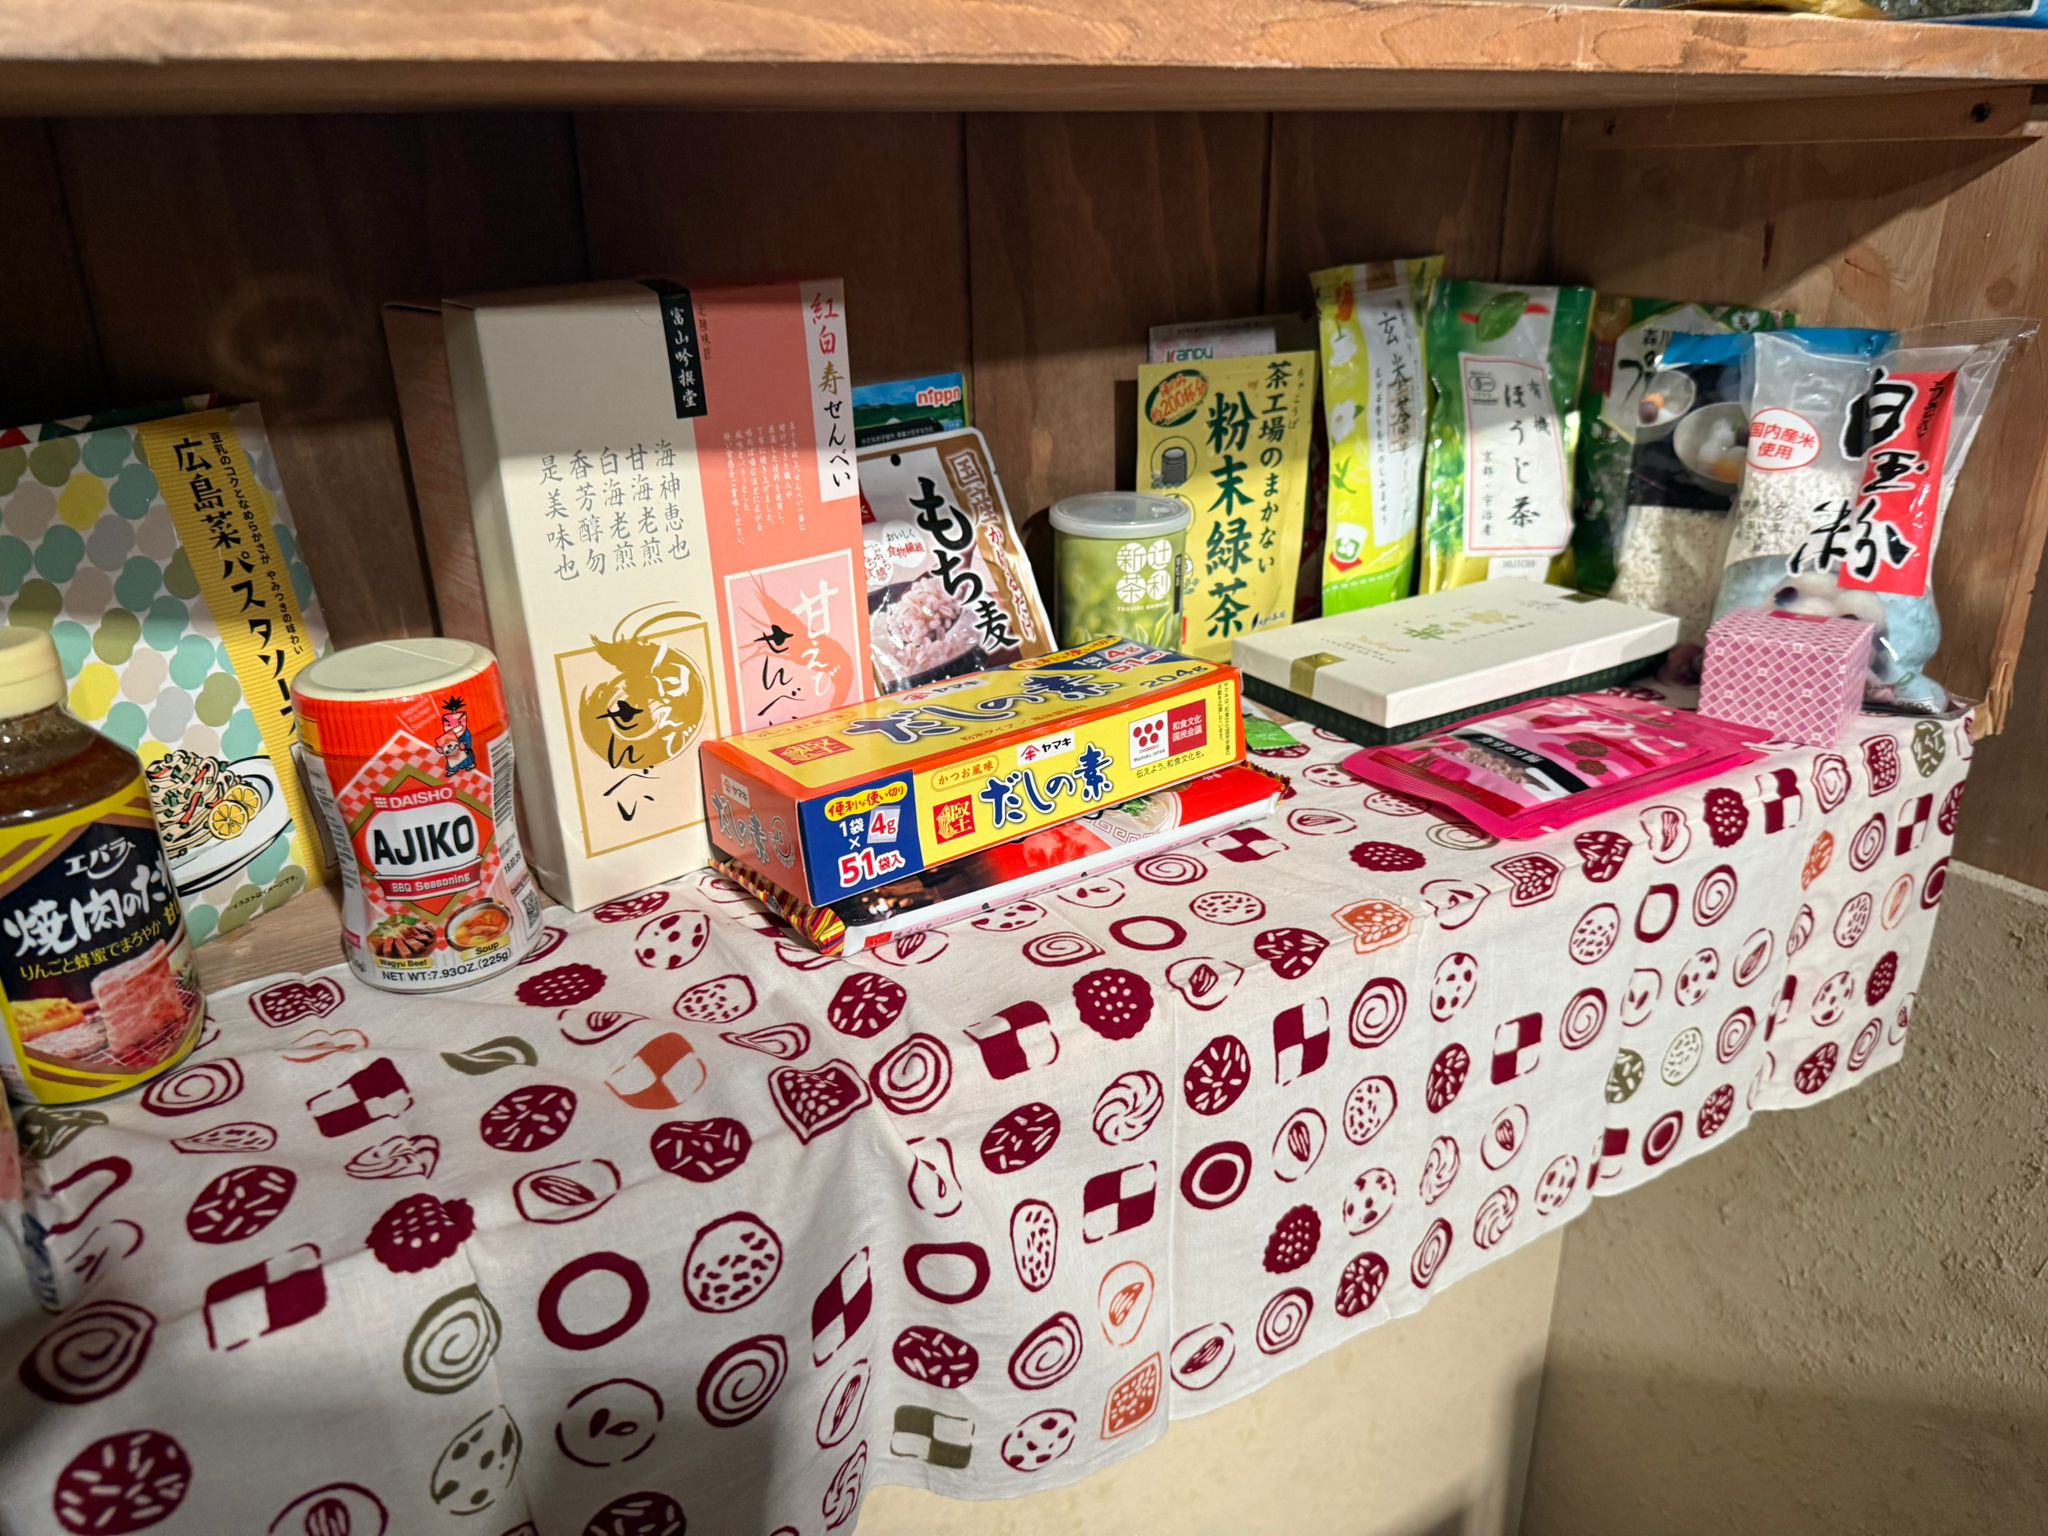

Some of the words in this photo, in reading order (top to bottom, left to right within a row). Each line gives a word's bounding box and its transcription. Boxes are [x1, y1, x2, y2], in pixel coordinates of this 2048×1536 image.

[808, 293, 851, 487] 紅白寿せんべい
[917, 386, 961, 406] nippn
[1528, 378, 1550, 437] 有機
[1504, 383, 1541, 528] ほうじ茶
[1750, 421, 1816, 449] 国内産米
[1757, 444, 1793, 460] 使用
[948, 451, 999, 524] 国産
[1258, 360, 1294, 574] 茶工場のまかない
[1788, 367, 1927, 581] 白玉粉
[540, 454, 580, 581] 是美味也
[600, 446, 637, 571] 白海老煎
[625, 443, 663, 568] 甘海老煎
[654, 439, 690, 560] 海神恵也
[1203, 391, 1258, 638] 粉末緑茶
[909, 476, 1020, 651] もち麦
[1116, 543, 1147, 604] 新茶
[266, 570, 304, 656] やみつきの味わい
[791, 577, 840, 697] 甘えび
[650, 639, 697, 759] 白えび
[754, 624, 806, 727] せんべ
[1139, 666, 1208, 688] 204g
[841, 673, 1121, 744] だしの素
[1172, 714, 1202, 730] 和食文化
[1172, 724, 1203, 742] 国民会議
[595, 700, 660, 822] せんべい
[938, 760, 994, 785] かつお風味
[1041, 737, 1072, 752] ヤマキ
[390, 787, 453, 809] DAISHO
[828, 785, 904, 817] 便利な使い切り
[979, 744, 1113, 827] だしの素
[374, 814, 475, 866] AJIKO
[711, 788, 770, 864] だしの素
[839, 817, 864, 837] 1袋
[871, 812, 896, 834] 4g
[64, 837, 136, 878] エバラ
[391, 881, 412, 893] BBQ
[415, 872, 471, 892] Seasoning
[840, 849, 904, 885] 51袋入
[19, 920, 162, 981] りんごと蜂蜜でまろやか
[379, 958, 406, 968] Wagyu
[382, 971, 404, 981] NET
[475, 942, 499, 955] Soup
